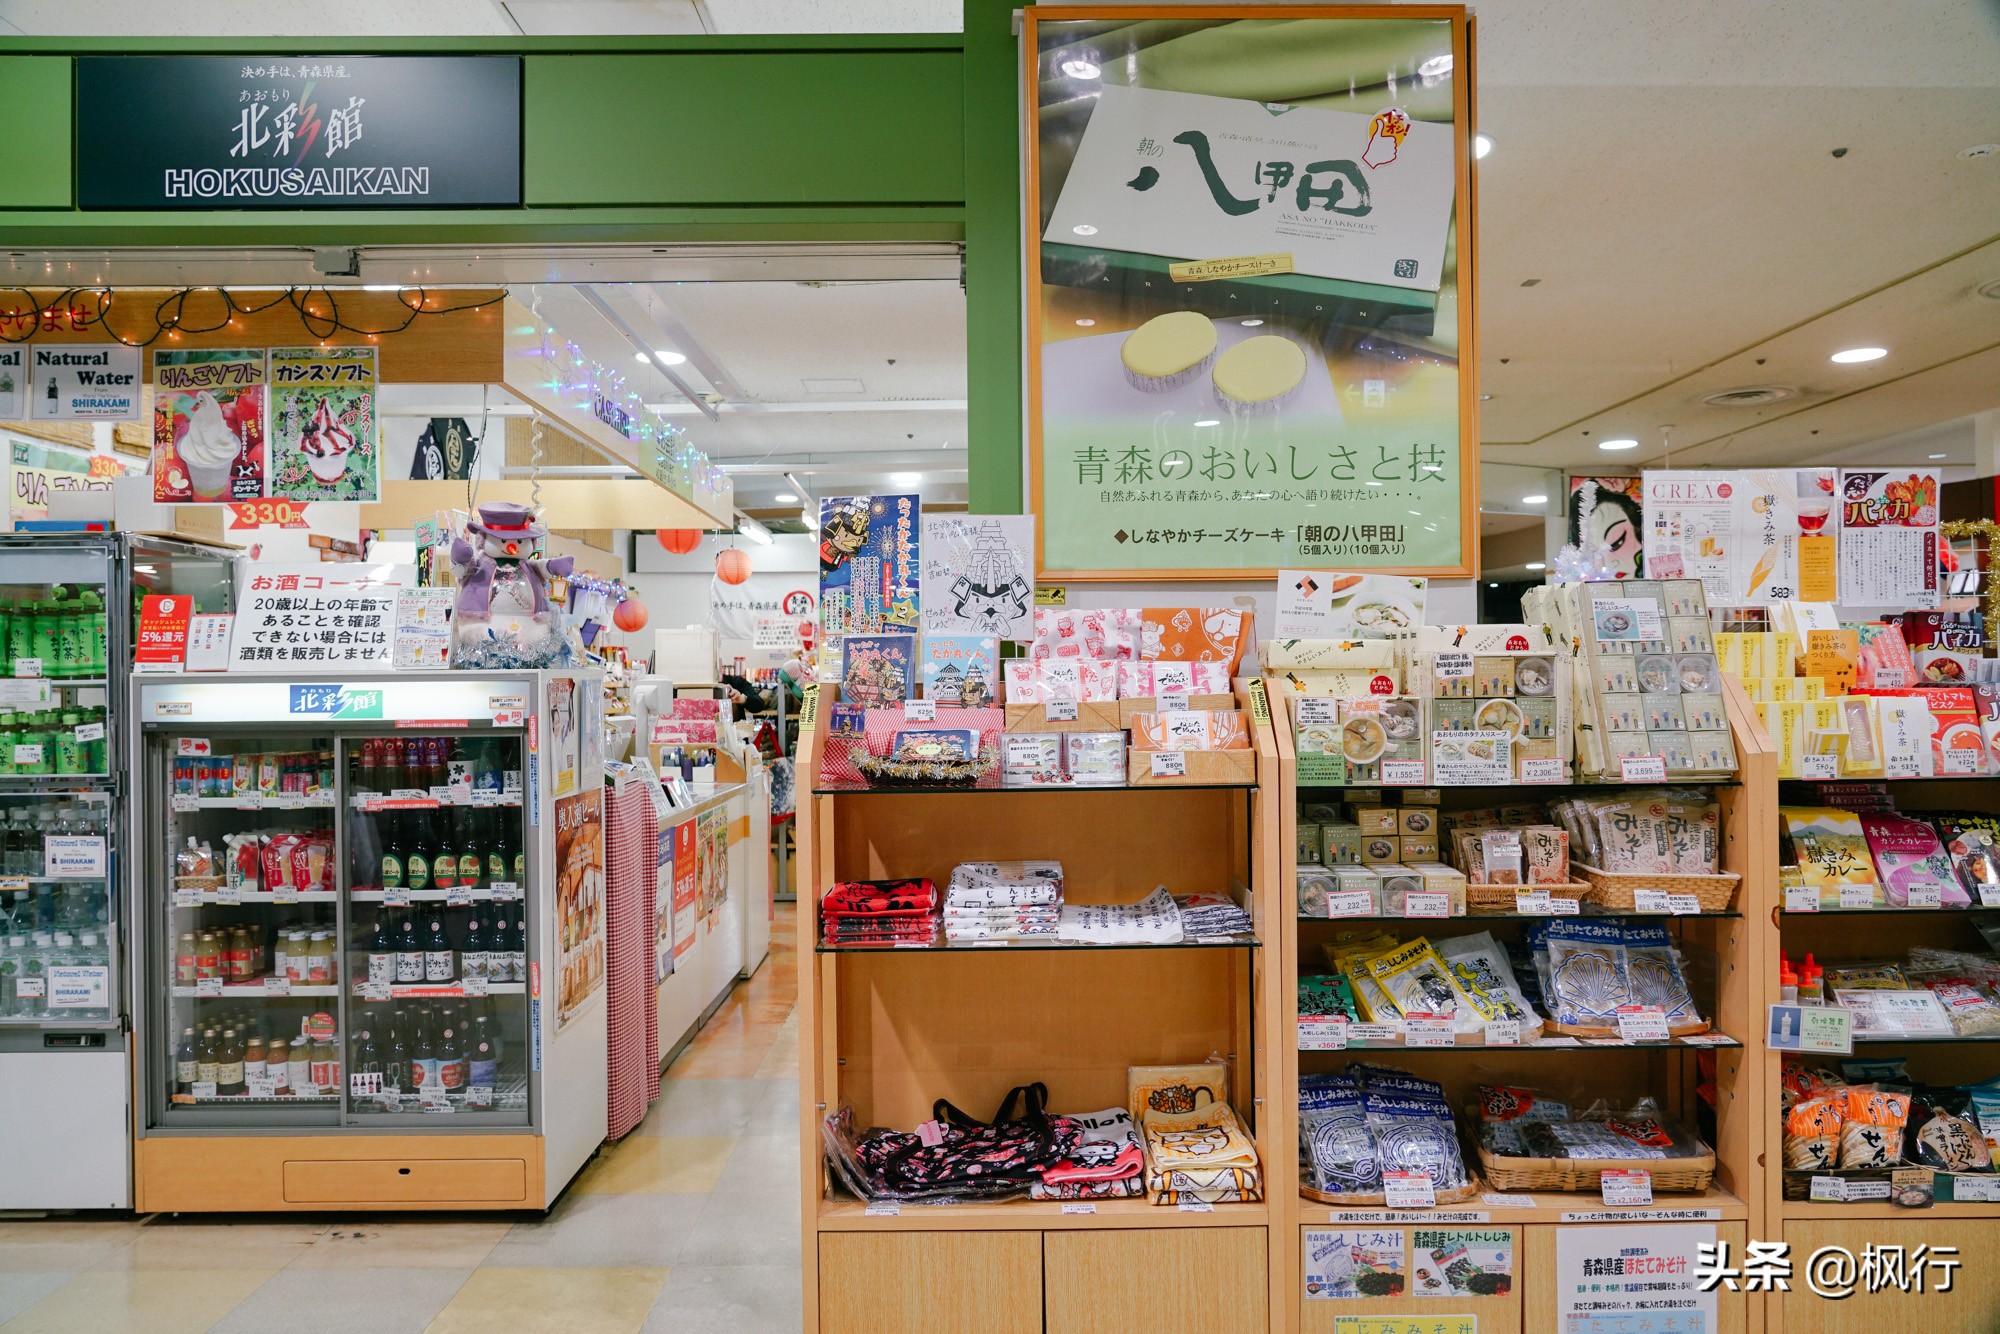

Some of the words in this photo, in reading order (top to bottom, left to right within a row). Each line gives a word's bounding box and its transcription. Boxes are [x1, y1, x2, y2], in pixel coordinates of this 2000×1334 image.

[241, 65, 352, 79] 決め手は、青森県産。
[239, 89, 291, 102] あおもり
[230, 84, 366, 165] 北彩館
[1136, 137, 1164, 157] 朝の
[165, 166, 429, 197] HOKUSAIKAN
[1279, 213, 1299, 221] ASA
[36, 351, 109, 366] Natural
[77, 371, 134, 386] Water
[160, 363, 262, 389] りんごソフト
[276, 364, 371, 382] カシスソフト
[72, 399, 130, 408] SHIRAKAMI
[361, 394, 372, 455] カシスソース
[1073, 443, 1447, 485] 青森のおいしさと技
[1653, 482, 1713, 498] CREA
[241, 504, 301, 524] 330円
[1845, 498, 1911, 525] パイカ
[1763, 494, 1776, 546] 嶽きみ茶
[251, 575, 402, 592] お酒コーナー
[1771, 586, 1795, 599] 583円
[254, 598, 393, 611] 20歳以上の年齢で
[897, 605, 909, 619] 2
[263, 615, 381, 628] あることを確認
[141, 631, 185, 643] 5%還元
[253, 631, 386, 644] できない場合には
[1812, 634, 1839, 642] おいしい
[1928, 629, 1981, 652] パイカ
[1812, 642, 1847, 650] 嶽きみ茶の
[239, 647, 393, 661] 酒類を販売しません
[850, 648, 903, 660] たか丸くん
[931, 648, 985, 660] たか丸くん
[1812, 651, 1836, 659] つくり方
[294, 691, 378, 718] 北彩館
[1257, 690, 1269, 718] WARNING
[558, 801, 599, 834] 奥入瀬ビール
[1869, 826, 1891, 837] 青森
[1807, 846, 1857, 864] 嶽きみ
[1823, 863, 1868, 878] カレー
[1386, 942, 1428, 968] しじみみそ汁
[1339, 1232, 1404, 1248] しじみ汁
[1583, 1255, 1687, 1277] 青森県産ほたてみそ汁
[1306, 1275, 1324, 1283] 簡単
